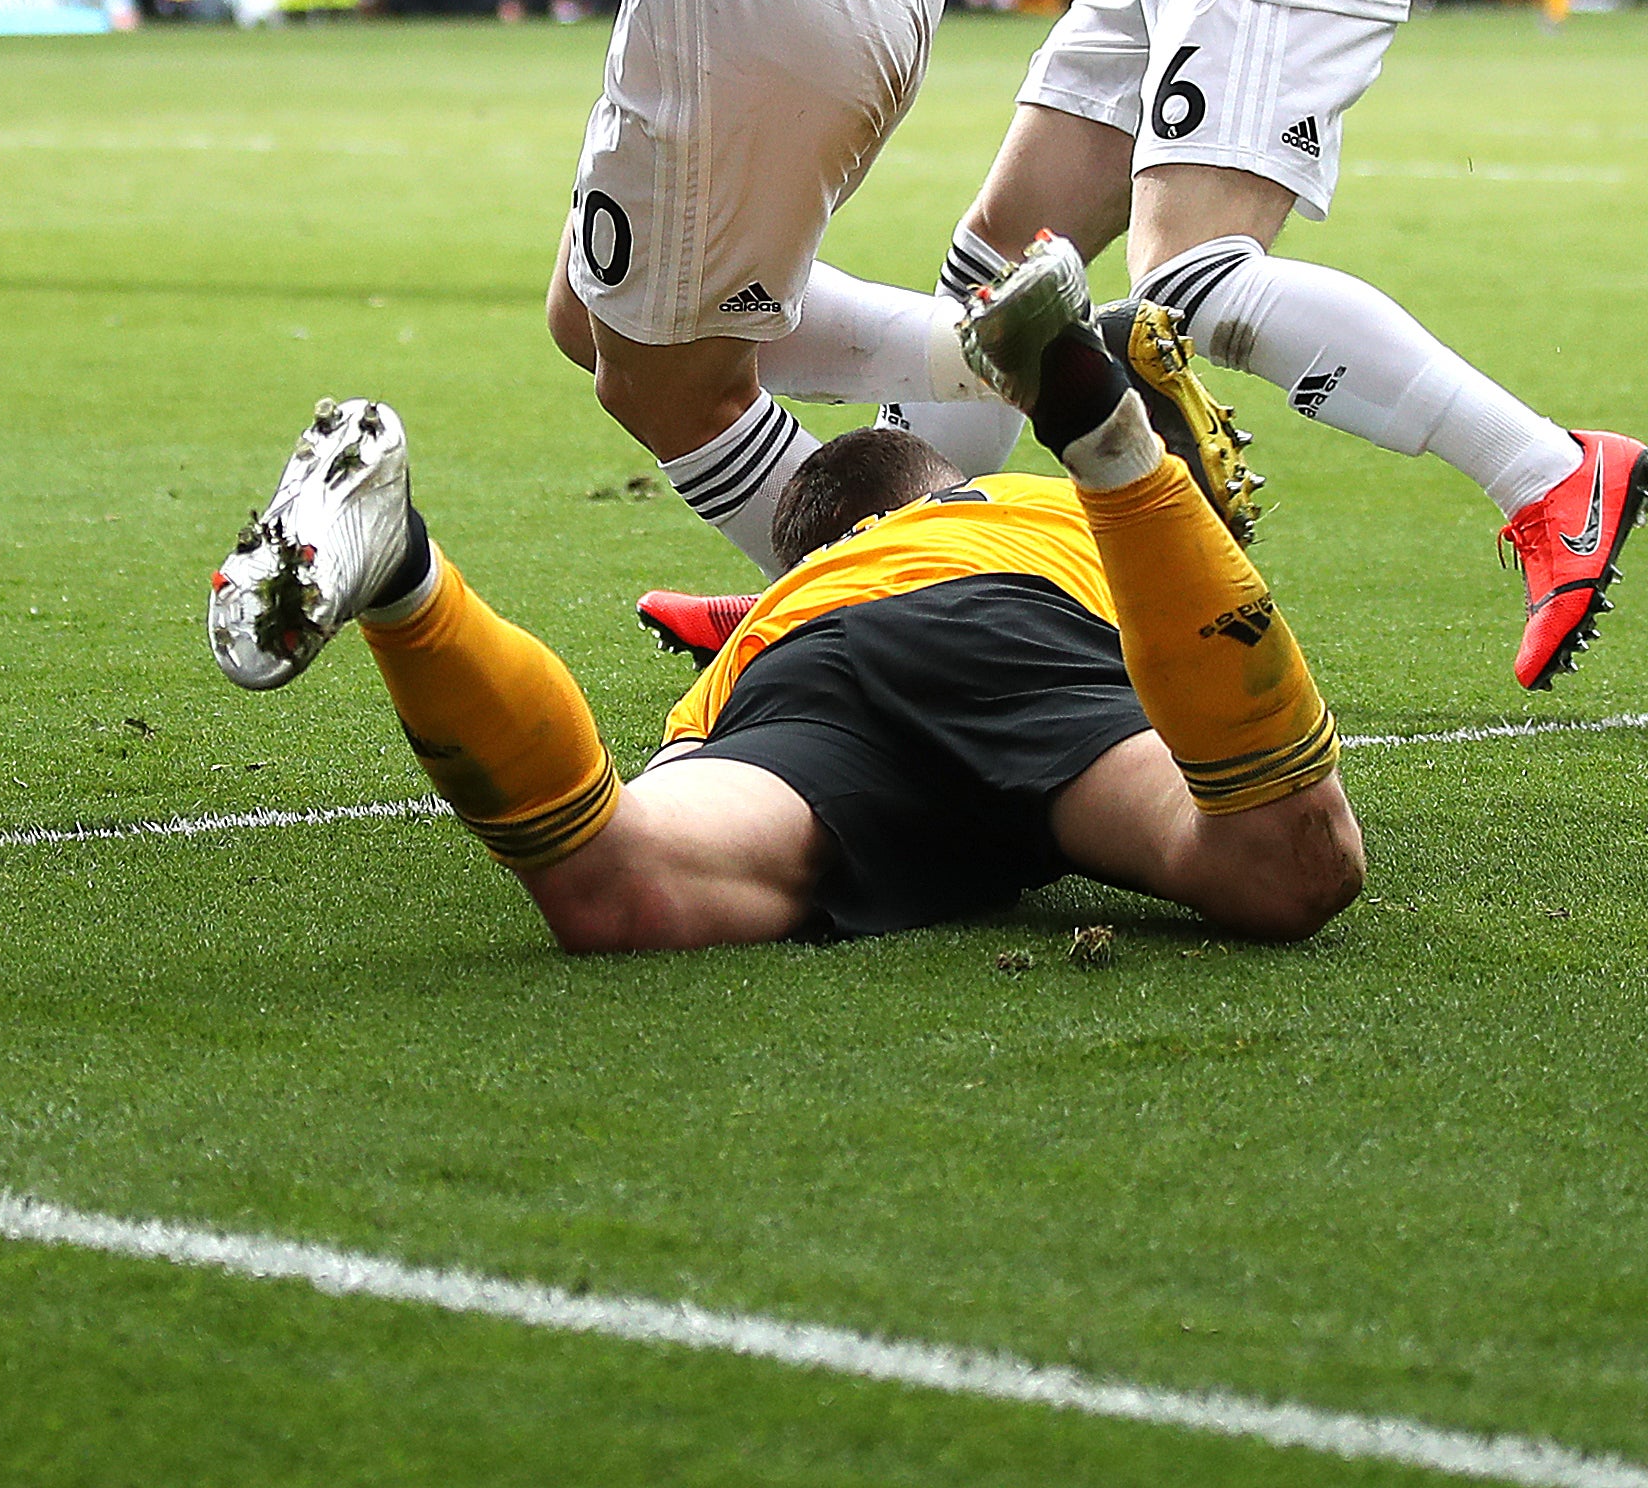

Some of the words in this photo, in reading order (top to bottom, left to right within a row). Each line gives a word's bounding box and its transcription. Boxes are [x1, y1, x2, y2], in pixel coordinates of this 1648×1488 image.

[1151, 45, 1206, 140] 6
[578, 189, 633, 287] 0
[718, 300, 783, 314] adidas
